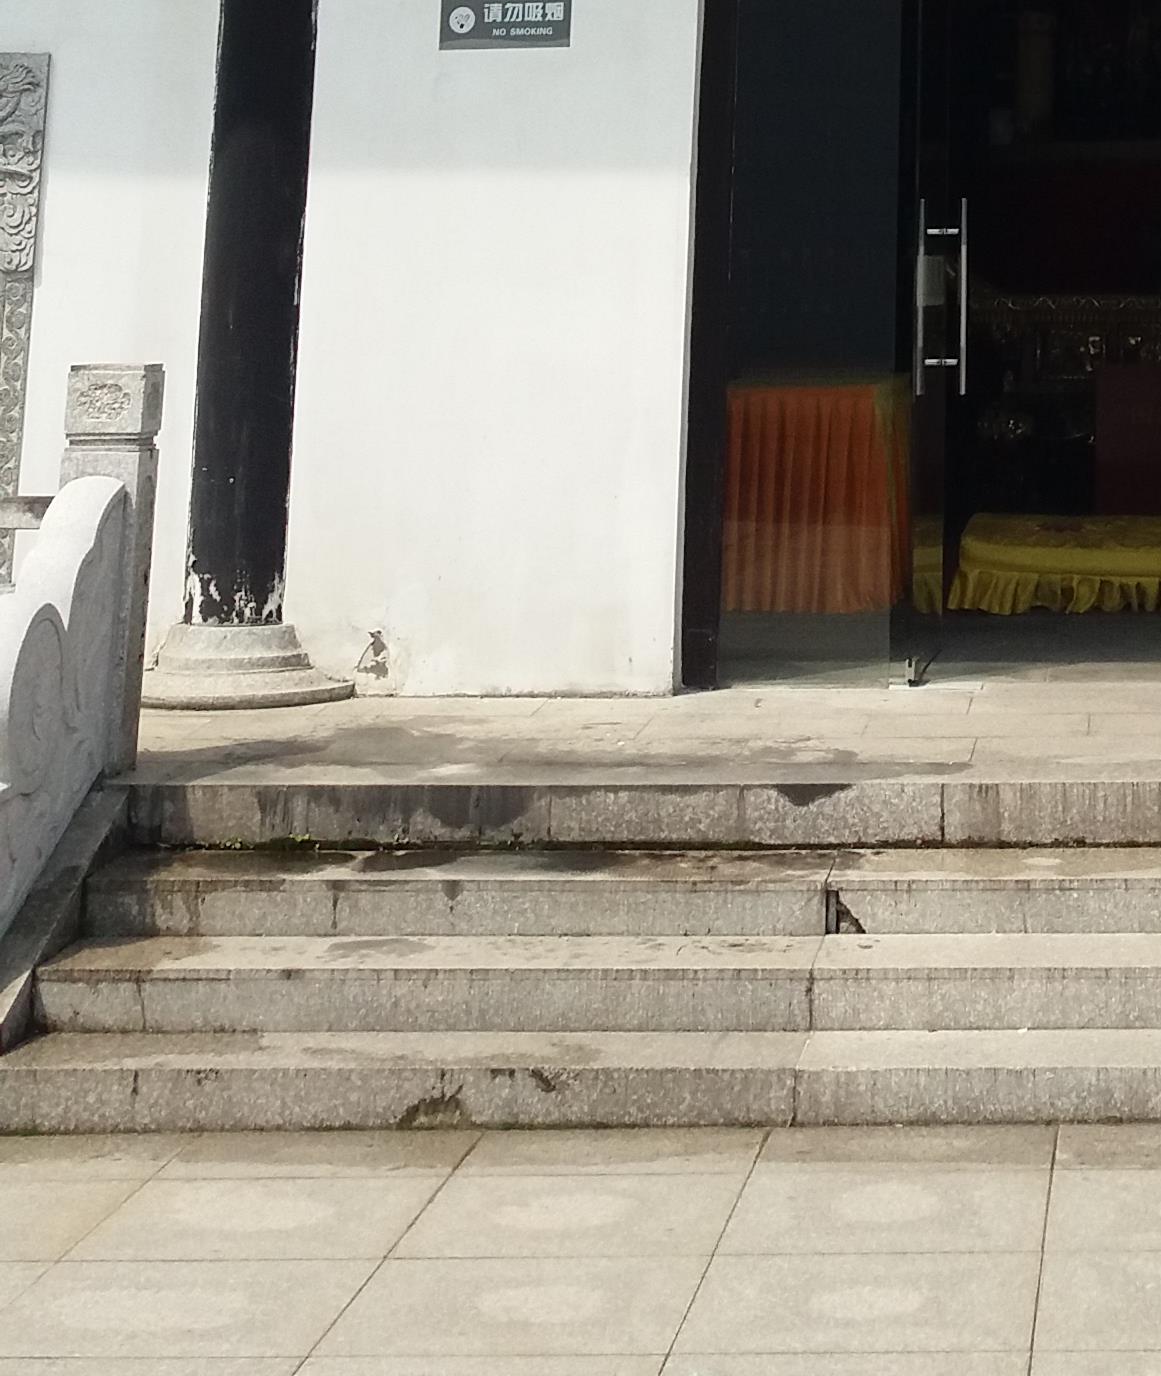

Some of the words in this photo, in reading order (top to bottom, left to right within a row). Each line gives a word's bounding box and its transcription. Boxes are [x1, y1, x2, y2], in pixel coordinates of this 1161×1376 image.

[483, 1, 565, 23] 请勿吸烟
[491, 27, 507, 37] NO
[509, 26, 553, 36] SMOKING
